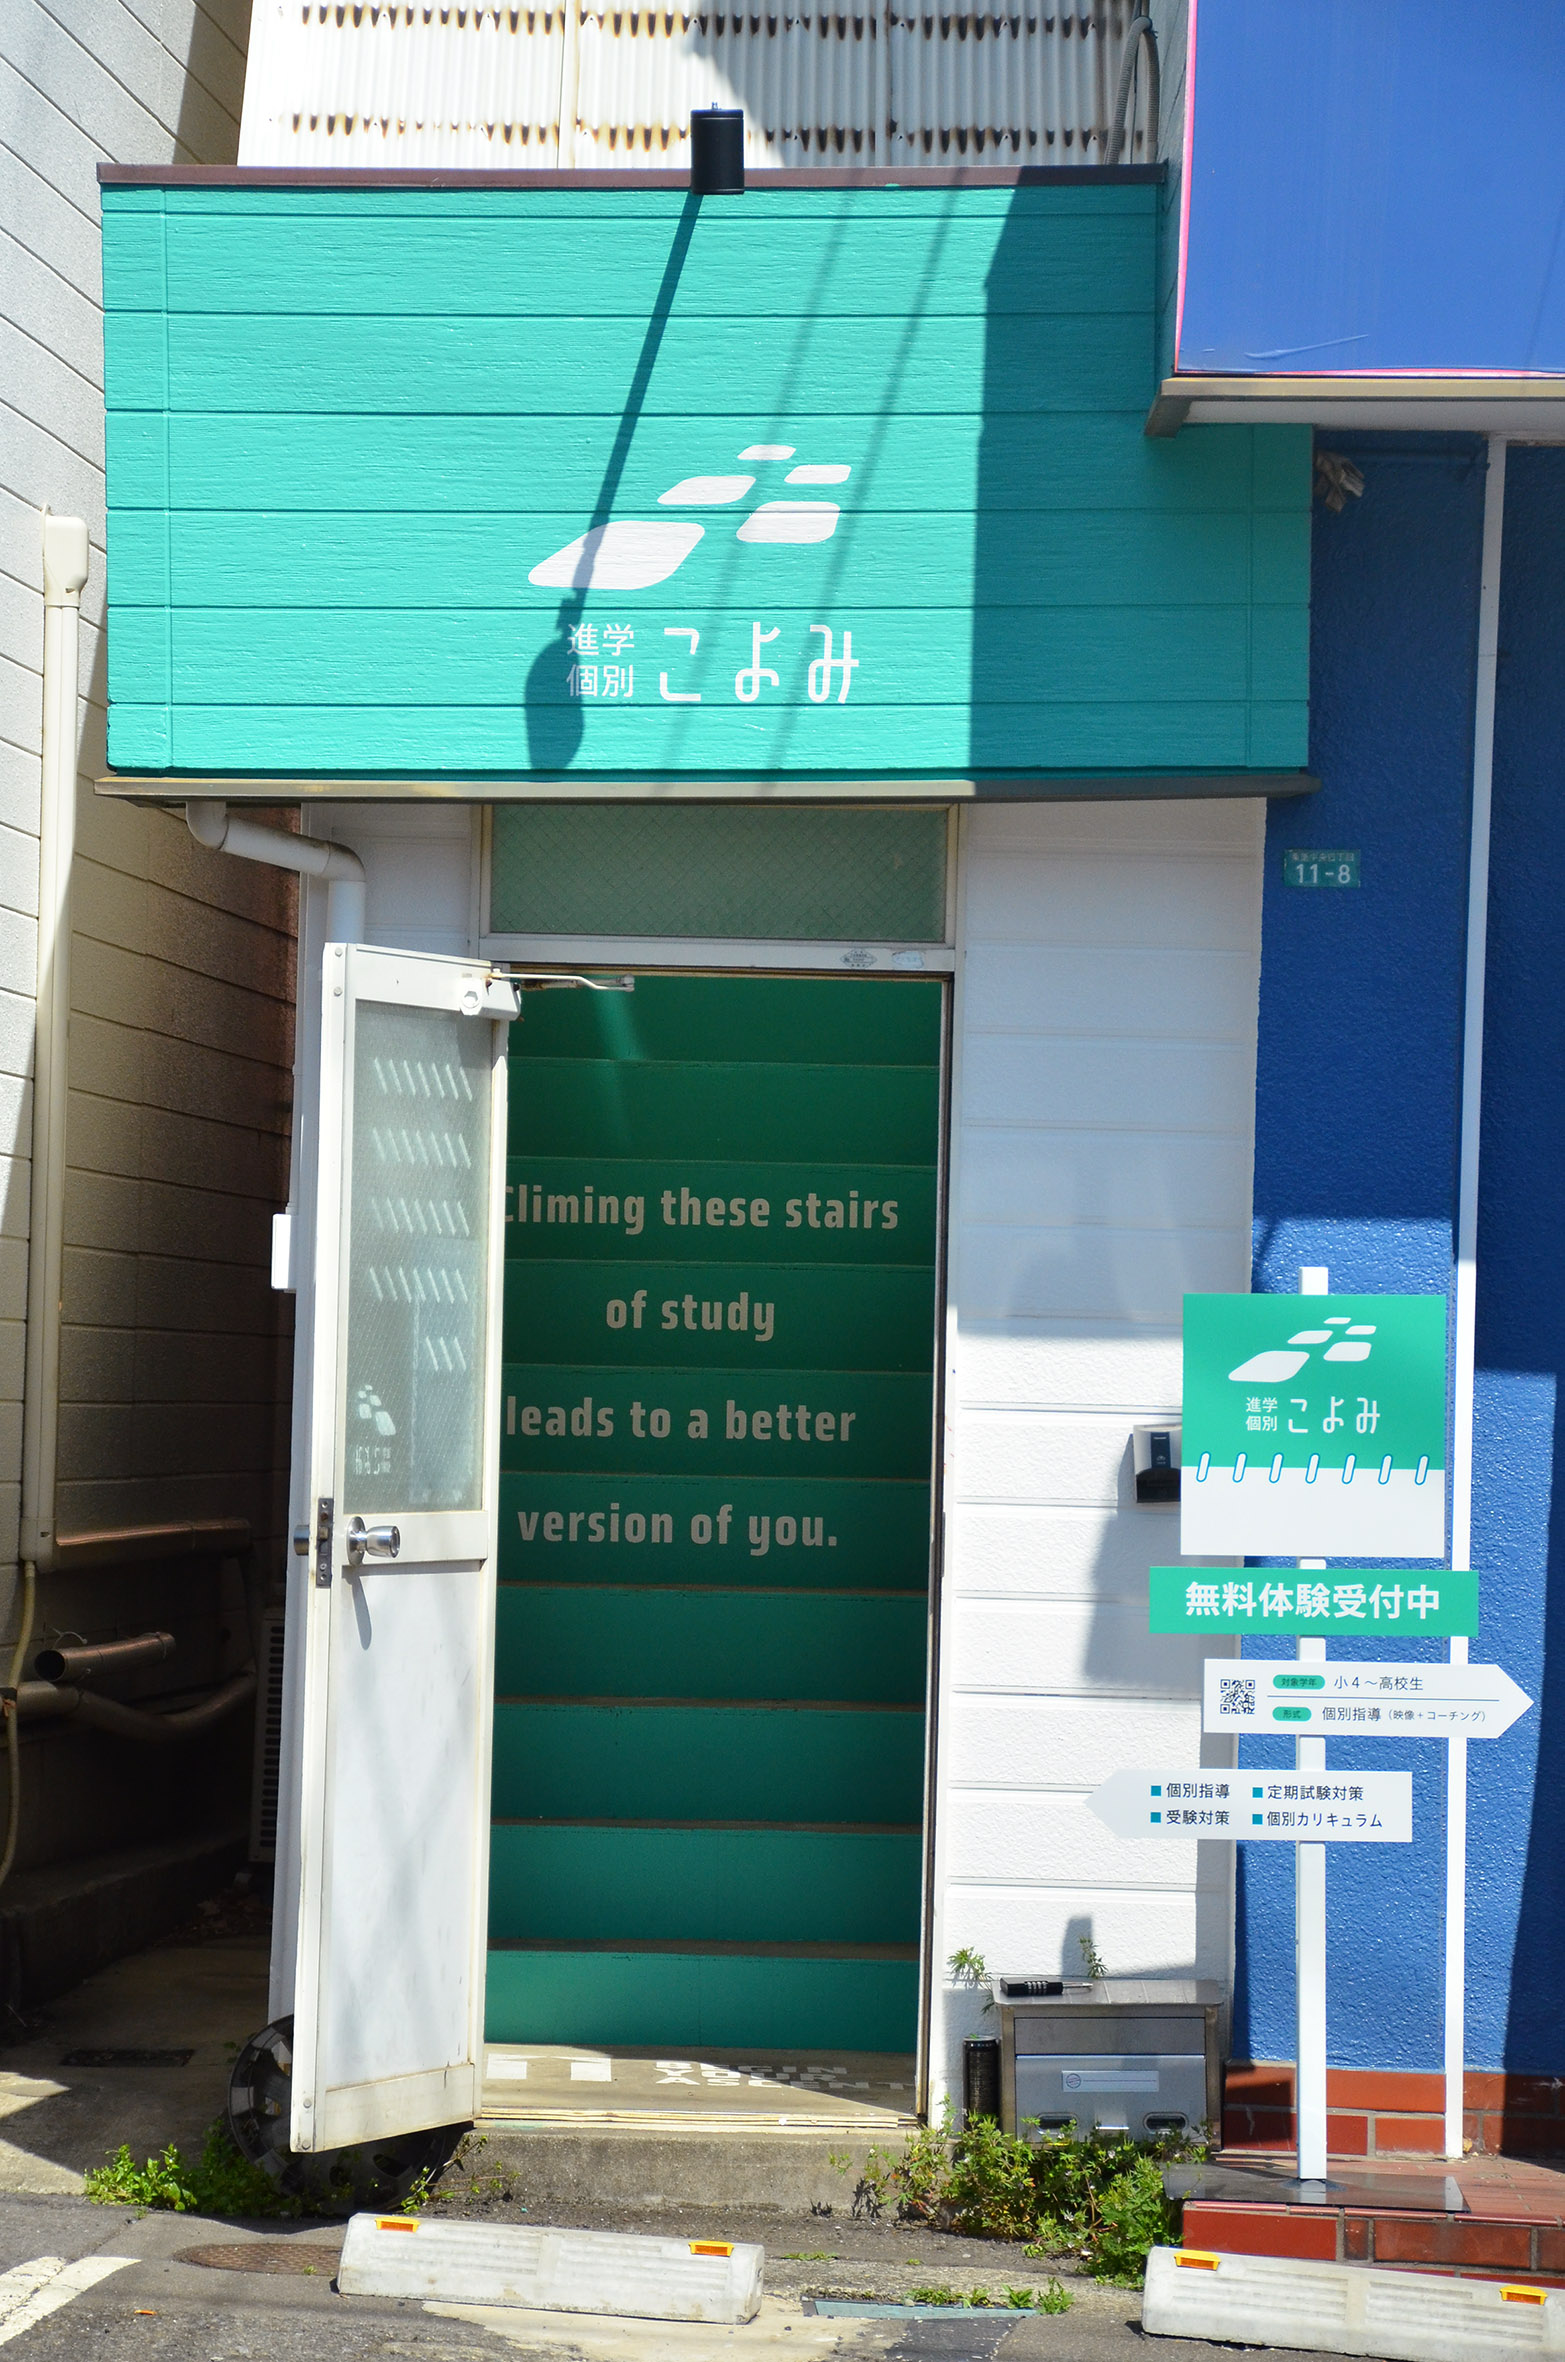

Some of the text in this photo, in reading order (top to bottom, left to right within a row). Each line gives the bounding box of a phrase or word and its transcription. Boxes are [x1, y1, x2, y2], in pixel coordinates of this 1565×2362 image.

[566, 623, 635, 657] 進学
[659, 621, 860, 704] こよみ
[565, 664, 635, 698] 個別
[1296, 863, 1351, 884] 11-8
[660, 1187, 771, 1228] these
[785, 1190, 899, 1230] stairs
[606, 1289, 776, 1342] of study
[506, 1395, 857, 1442] leads to a better
[1245, 1396, 1278, 1413] 進学
[1287, 1395, 1381, 1434] こよみ
[1245, 1415, 1278, 1432] 個別
[517, 1502, 838, 1557] version of you.
[1185, 1580, 1441, 1620] 無料体験受付中
[1166, 1782, 1364, 1801] 個別指導 定期試験対策
[1166, 1809, 1383, 1828] 受験対策 個別カリキュラム
[654, 2068, 837, 2081] YOUR
[655, 2061, 848, 2074] BEGIN
[655, 2076, 916, 2090] ASCENT
